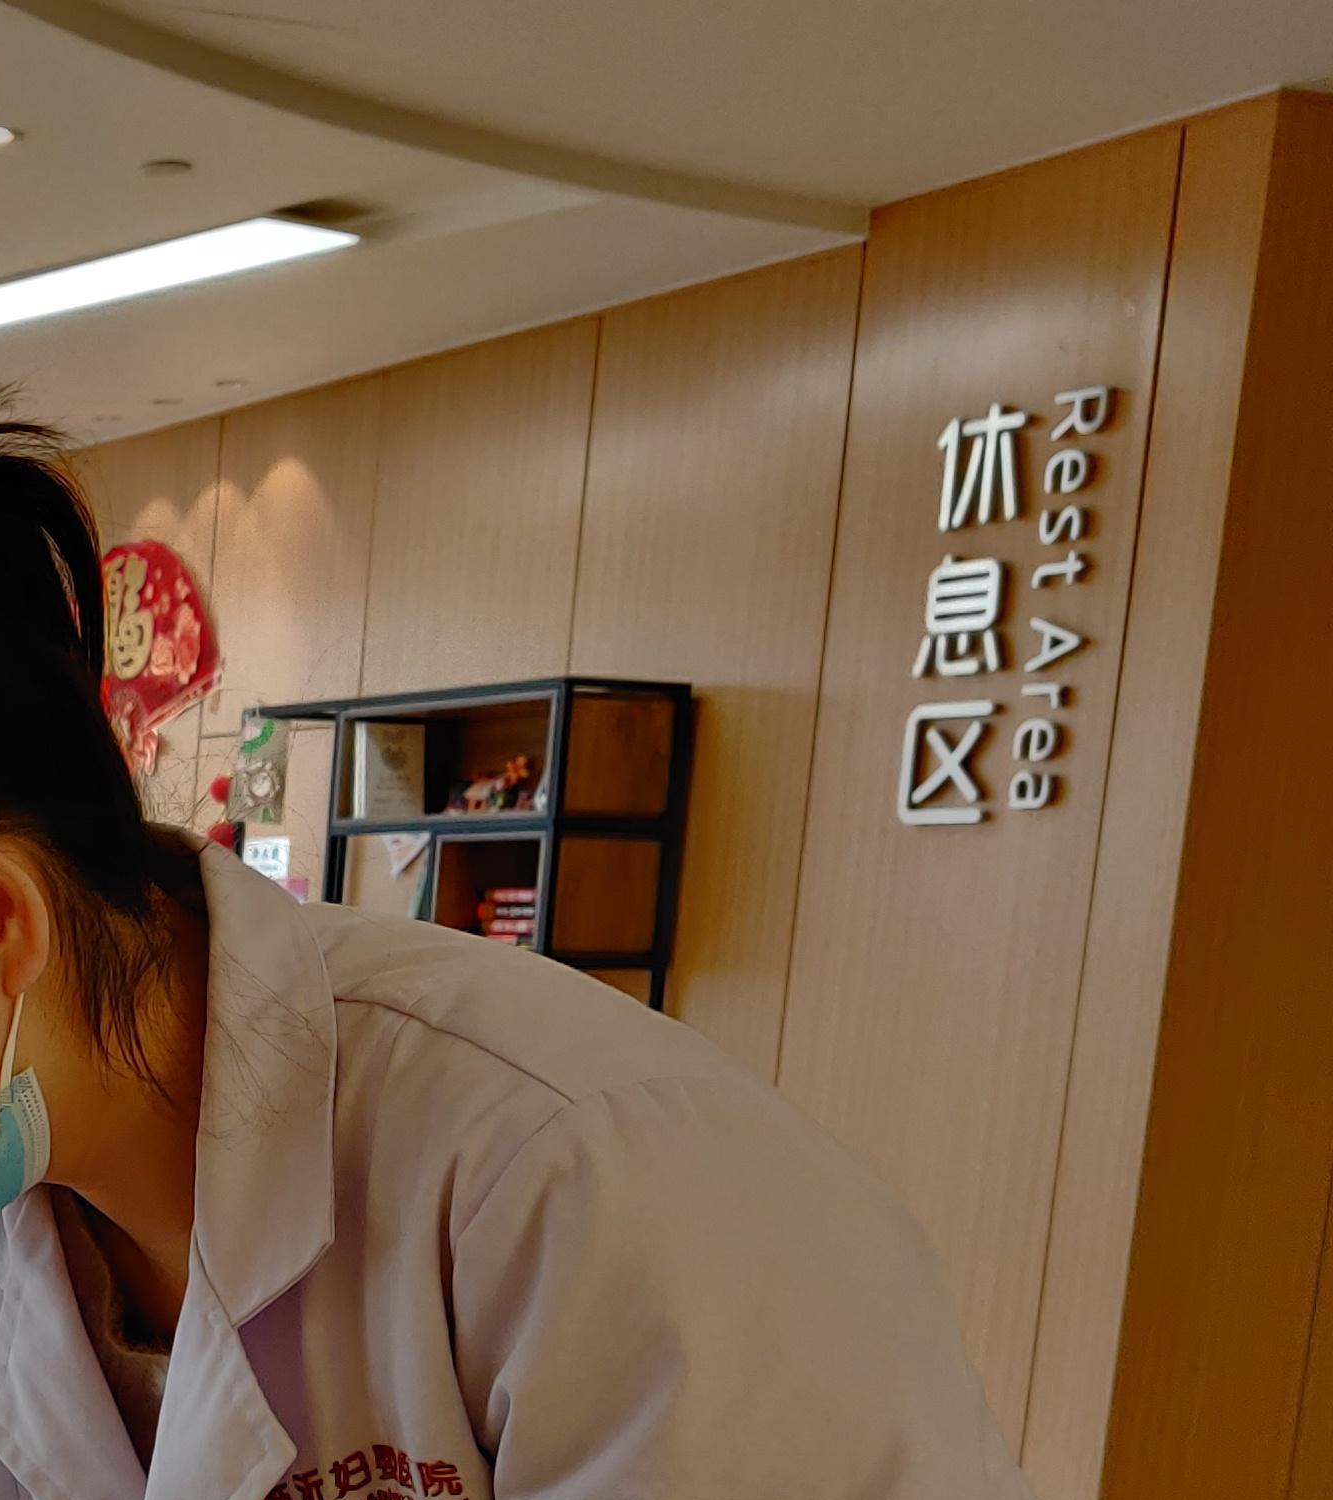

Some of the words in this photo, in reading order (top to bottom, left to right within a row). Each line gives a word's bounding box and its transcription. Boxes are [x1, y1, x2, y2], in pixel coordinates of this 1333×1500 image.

[1031, 385, 1109, 589] Rest
[897, 402, 1028, 826] 休息区
[1008, 617, 1082, 810] Area
